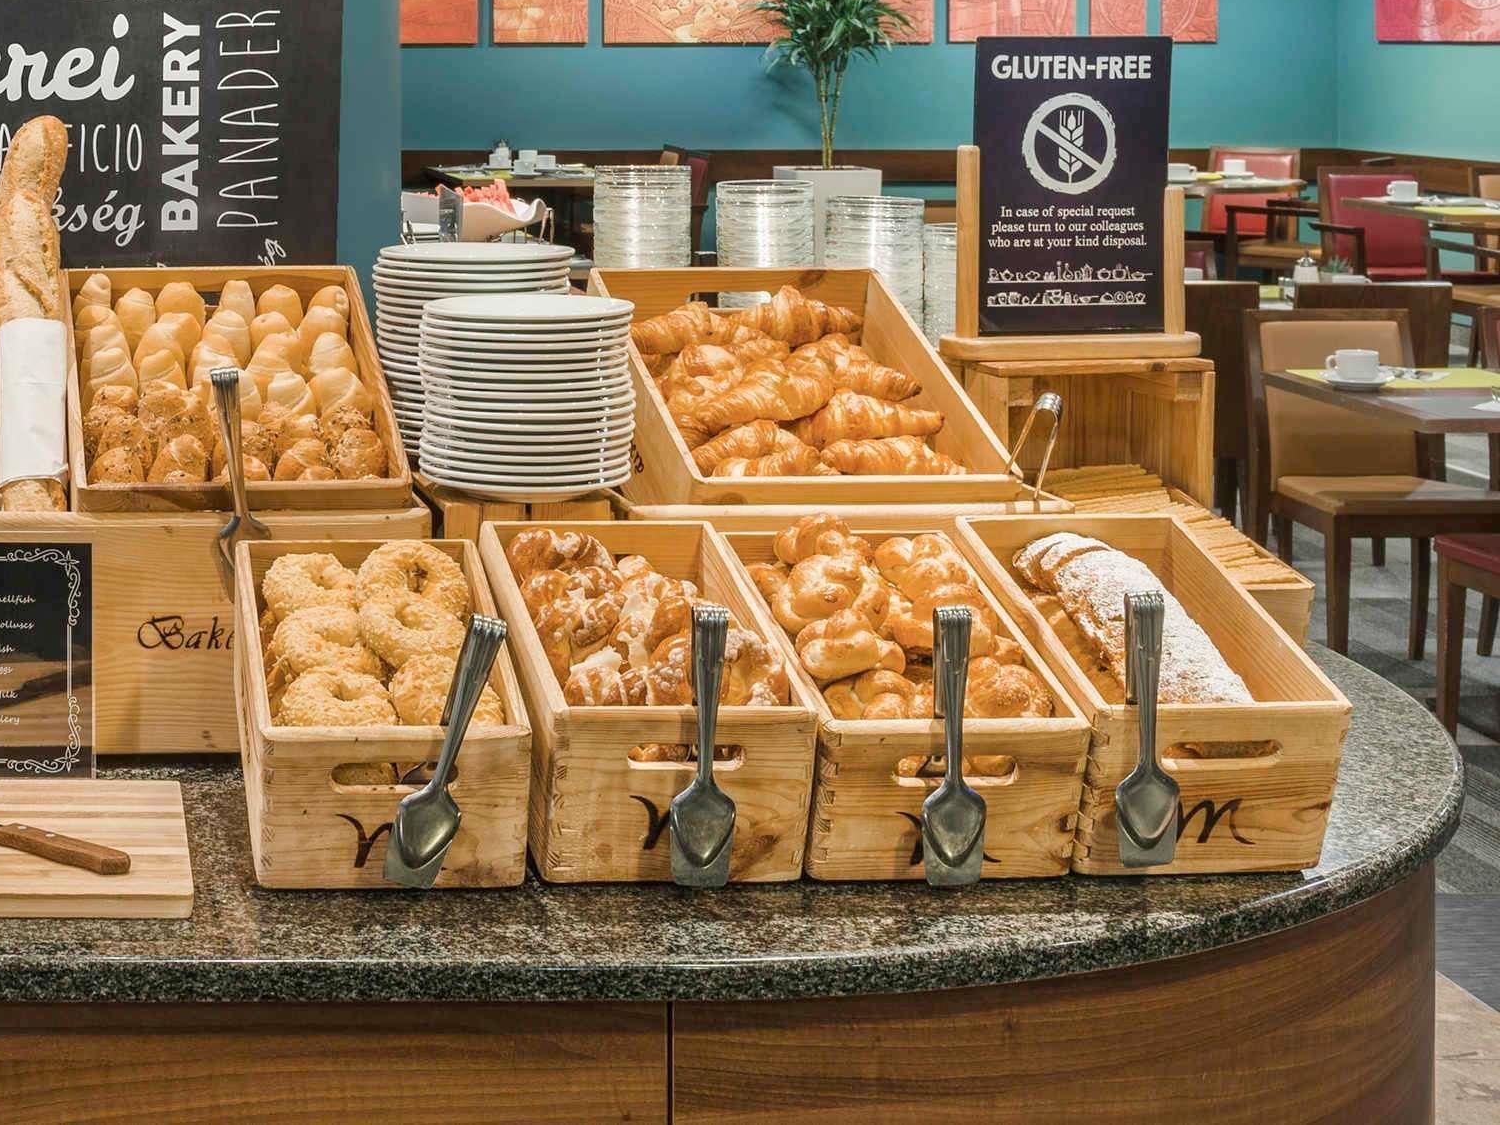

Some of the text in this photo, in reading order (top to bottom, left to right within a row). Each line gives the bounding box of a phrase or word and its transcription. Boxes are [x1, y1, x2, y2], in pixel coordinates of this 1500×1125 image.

[991, 54, 1152, 80] GLUTEN-FREE
[160, 11, 201, 231] BAKERY
[1000, 205, 1135, 219] In case of special request
[991, 220, 1144, 235] please turn to our colleagues
[988, 234, 1147, 250] who are at your kind disposal.
